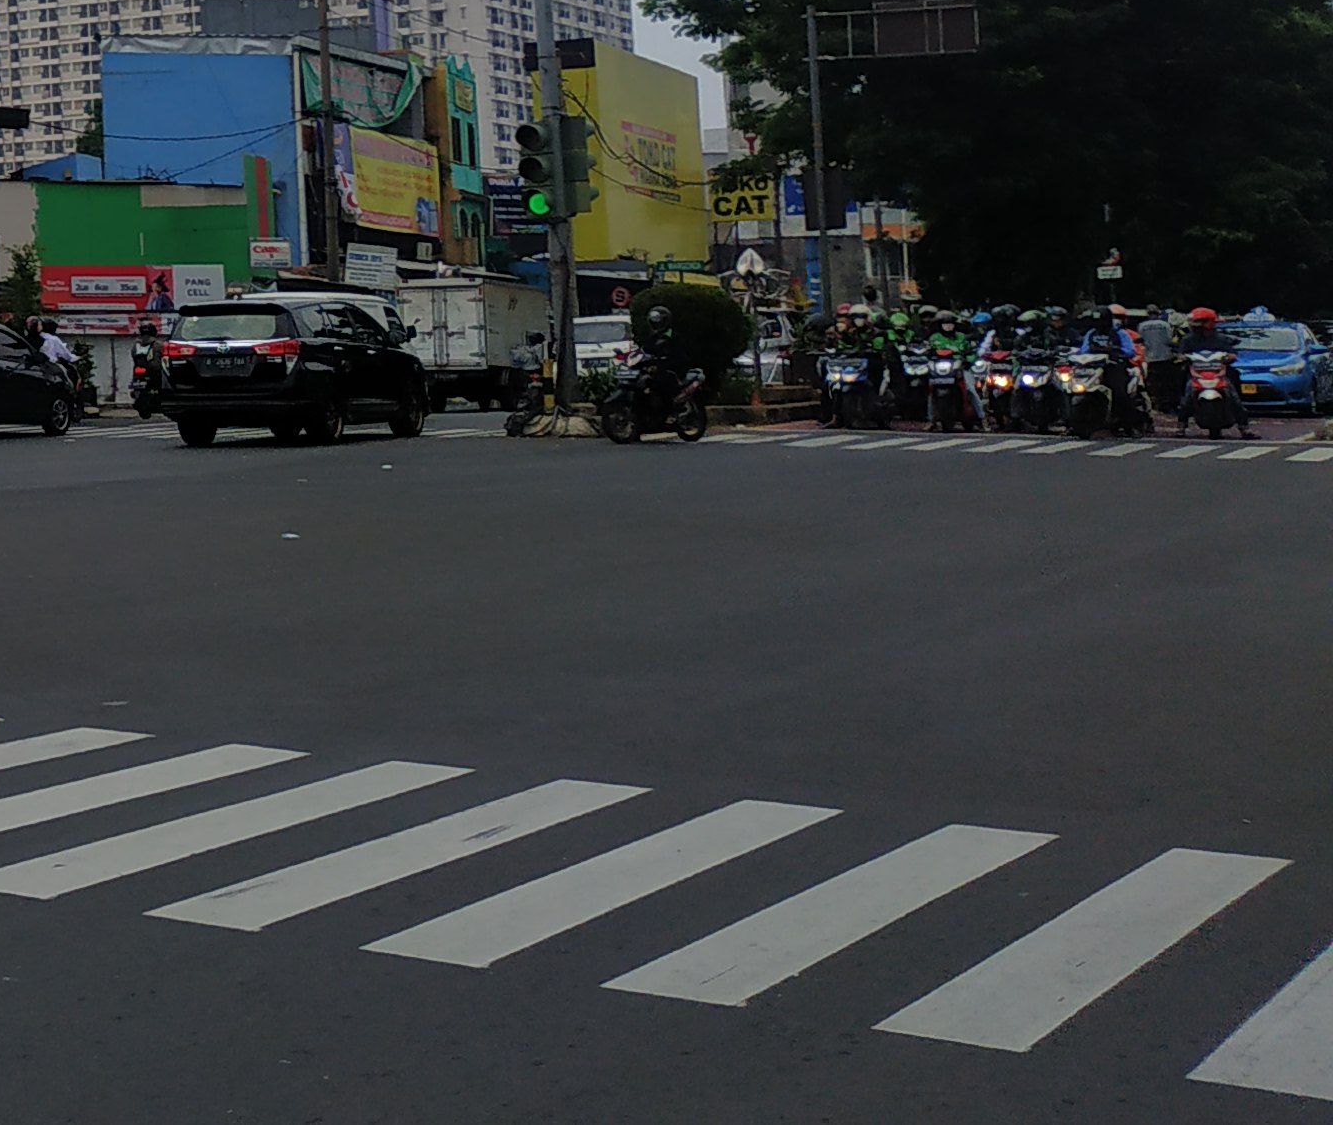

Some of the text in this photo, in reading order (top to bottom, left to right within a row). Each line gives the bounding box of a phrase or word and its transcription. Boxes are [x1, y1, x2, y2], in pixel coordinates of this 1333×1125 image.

[713, 195, 769, 216] CAT
[184, 278, 212, 287] PANG
[186, 288, 211, 297] CELL
